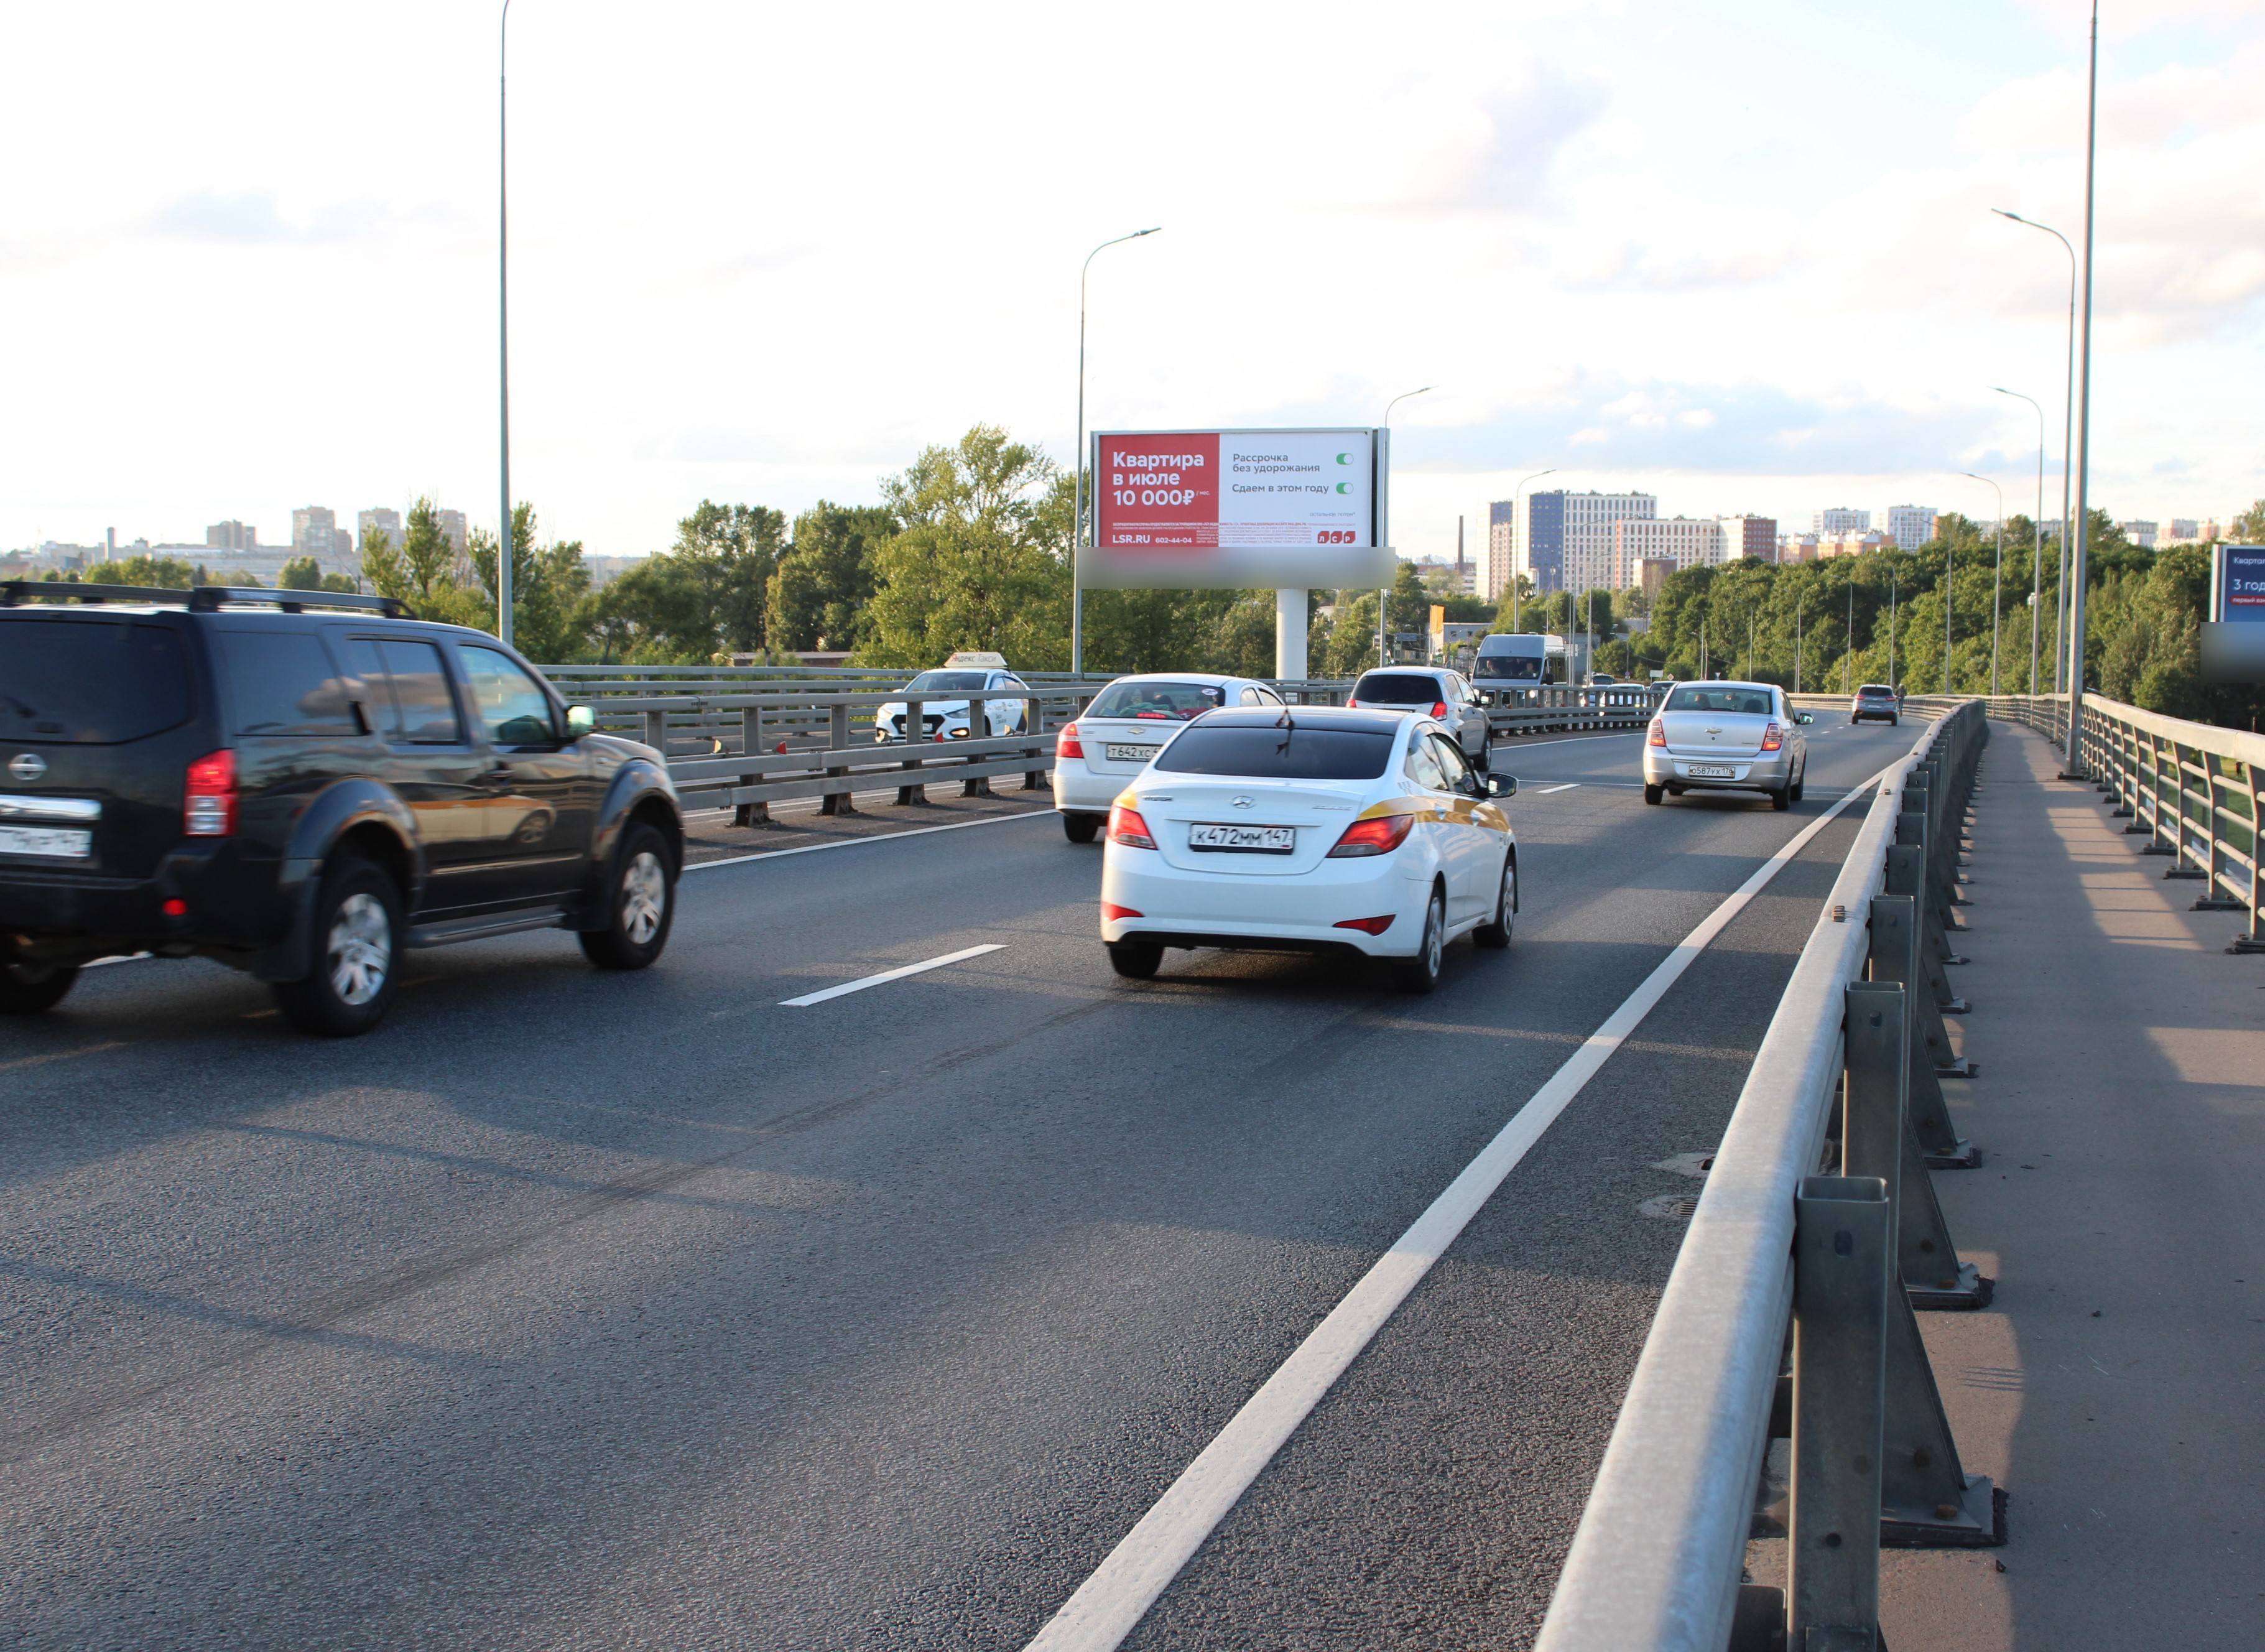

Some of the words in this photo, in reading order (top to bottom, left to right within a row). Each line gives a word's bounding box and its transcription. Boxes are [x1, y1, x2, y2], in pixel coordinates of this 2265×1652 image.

[1113, 452, 1204, 470] Квартира
[1233, 453, 1288, 463] Рассрочка
[1233, 463, 1251, 472] без
[1254, 465, 1320, 474] удорожания
[1113, 473, 1123, 485] в
[1129, 473, 1180, 485] июле
[1232, 483, 1265, 493] Сдаем
[1305, 485, 1329, 494] году
[1113, 490, 1136, 506] 10
[1142, 490, 1195, 506] 000₽
[1113, 534, 1151, 544] LSR.RU
[2234, 578, 2241, 590] 3
[952, 654, 975, 662] Яндекс
[978, 653, 997, 662] Такси
